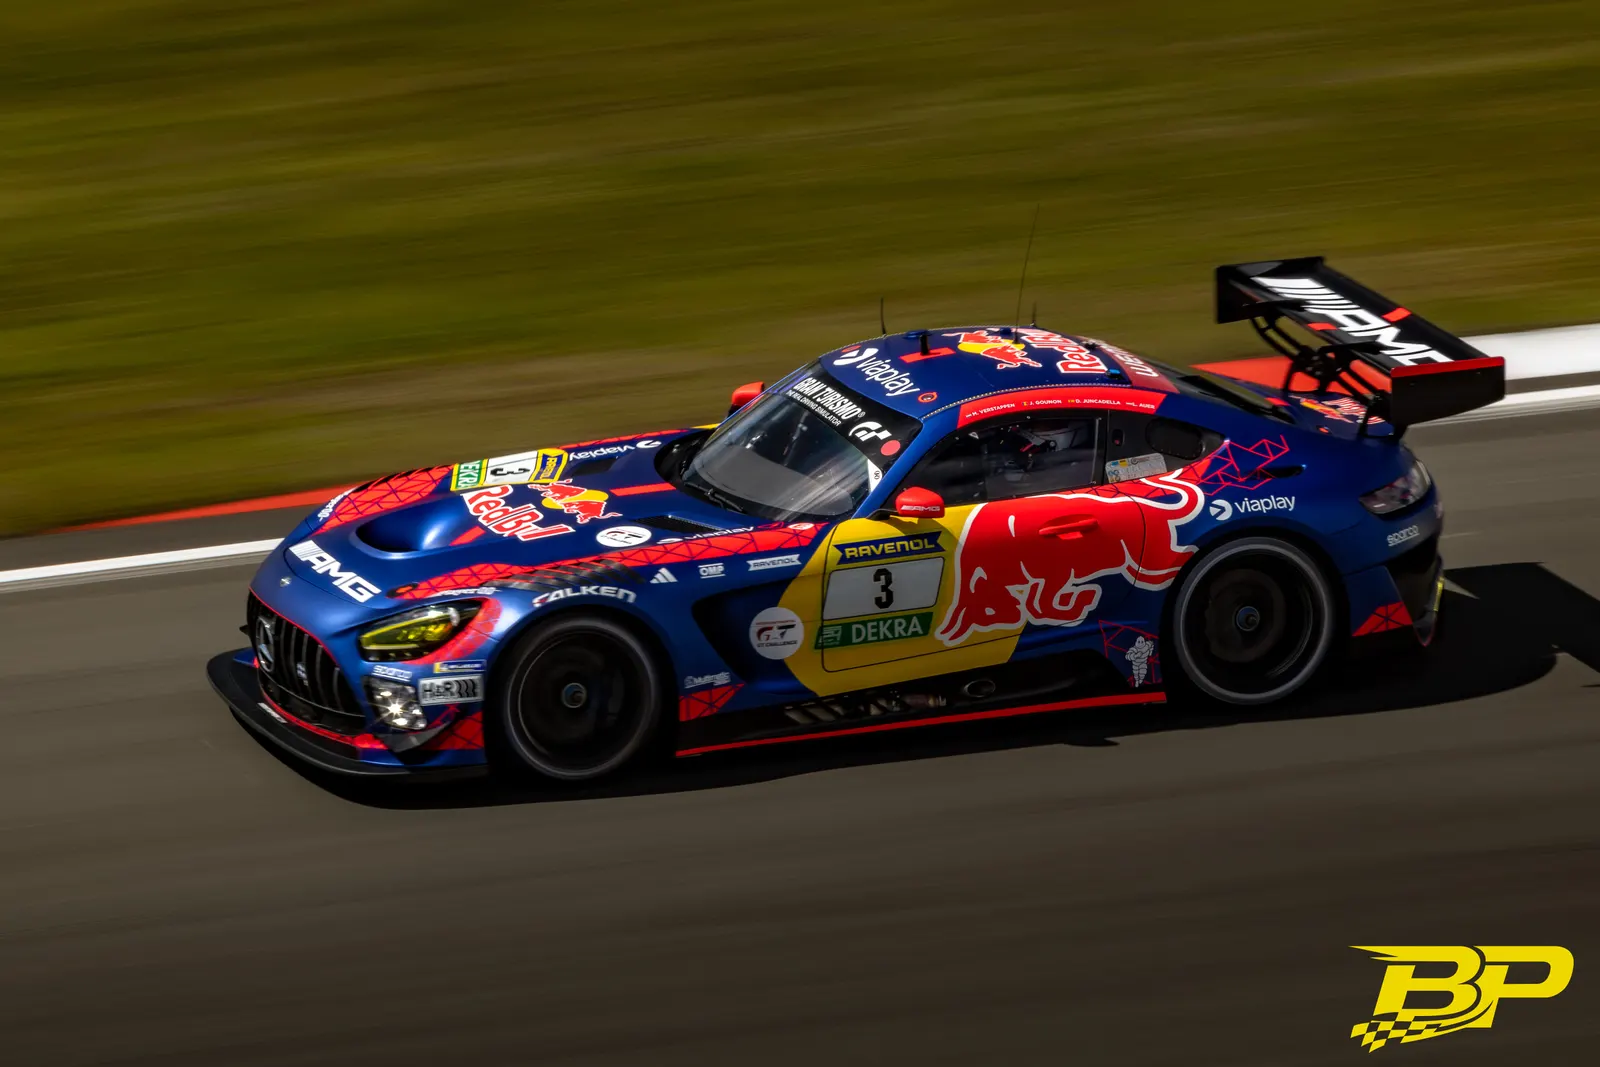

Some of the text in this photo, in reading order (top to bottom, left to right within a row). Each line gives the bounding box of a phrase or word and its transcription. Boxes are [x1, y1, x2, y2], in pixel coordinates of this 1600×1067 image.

[793, 377, 827, 397] GRAN
[856, 357, 920, 397] viaplay
[800, 397, 818, 410] DRIVING
[815, 406, 842, 427] SIMULATOR
[979, 403, 1015, 415] VERSTAPPEN
[569, 445, 635, 461] viaplay
[490, 468, 531, 477] 3
[1234, 495, 1296, 513] viaplay
[1387, 525, 1420, 545] sparco
[844, 538, 936, 559] RAVENOL
[699, 565, 725, 577] OMP
[752, 558, 796, 568] RAVENOL
[306, 551, 382, 603] AMG
[532, 586, 637, 608] FALKEN
[873, 568, 894, 609] 3
[851, 616, 924, 644] DEKRA
